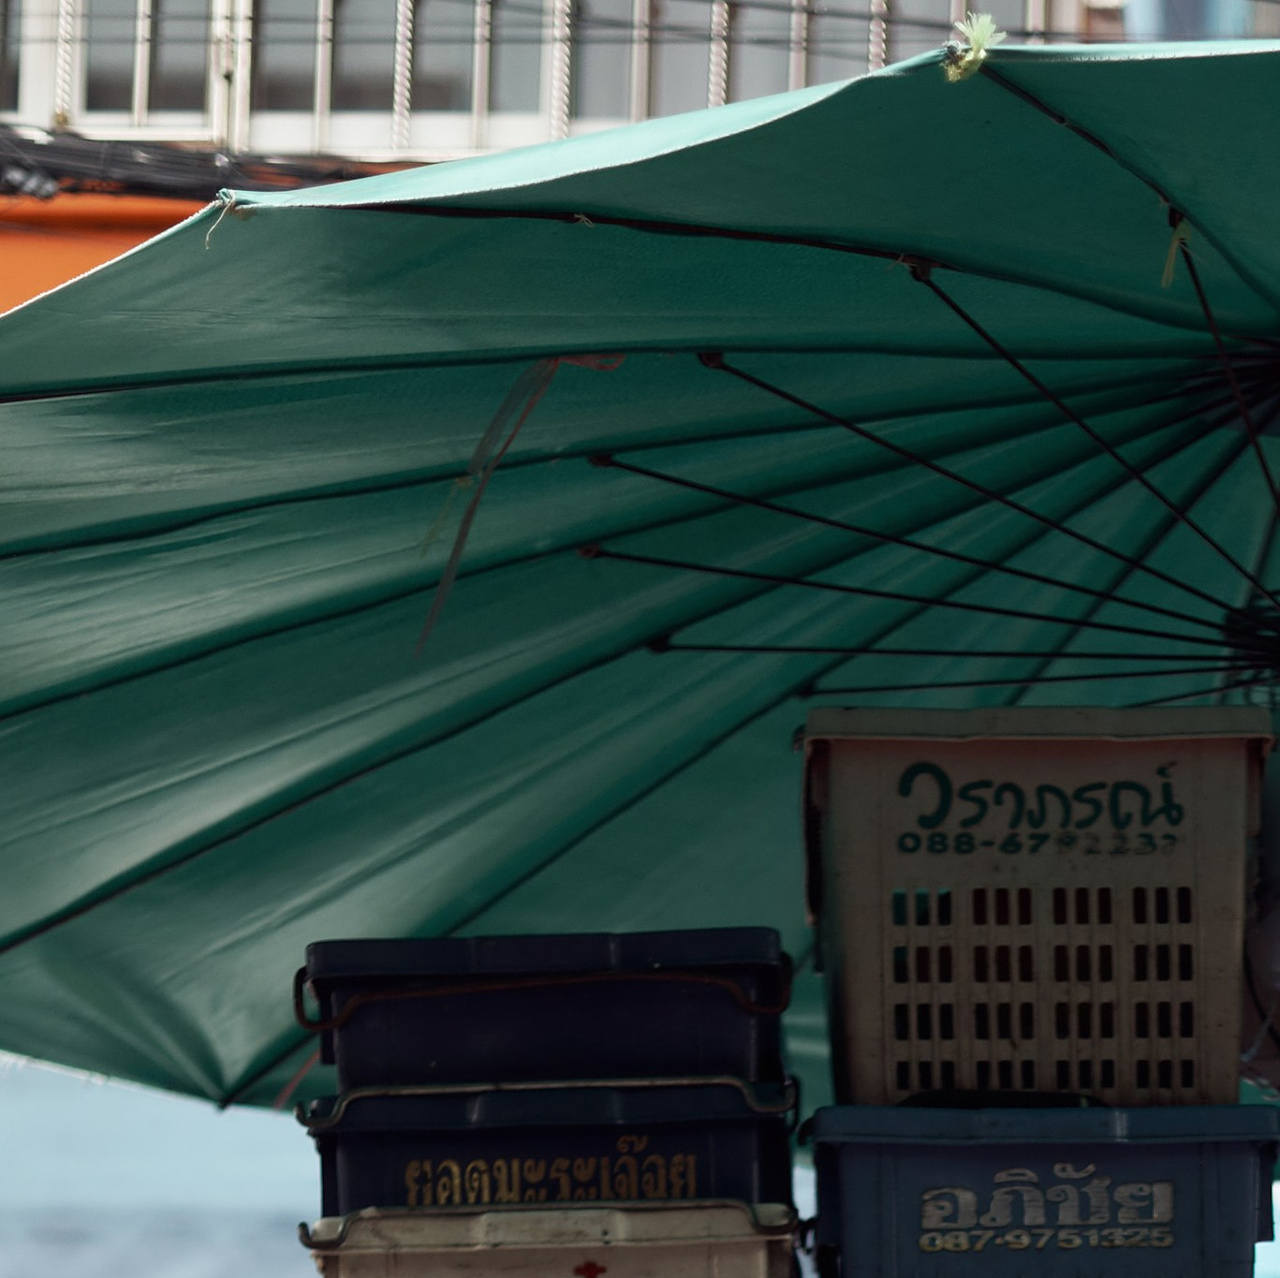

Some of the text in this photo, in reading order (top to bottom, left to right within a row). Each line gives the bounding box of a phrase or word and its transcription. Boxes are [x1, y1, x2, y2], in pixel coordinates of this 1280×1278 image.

[896, 761, 1184, 830] วราภรณ์
[919, 1162, 1175, 1229] อภิชัย
